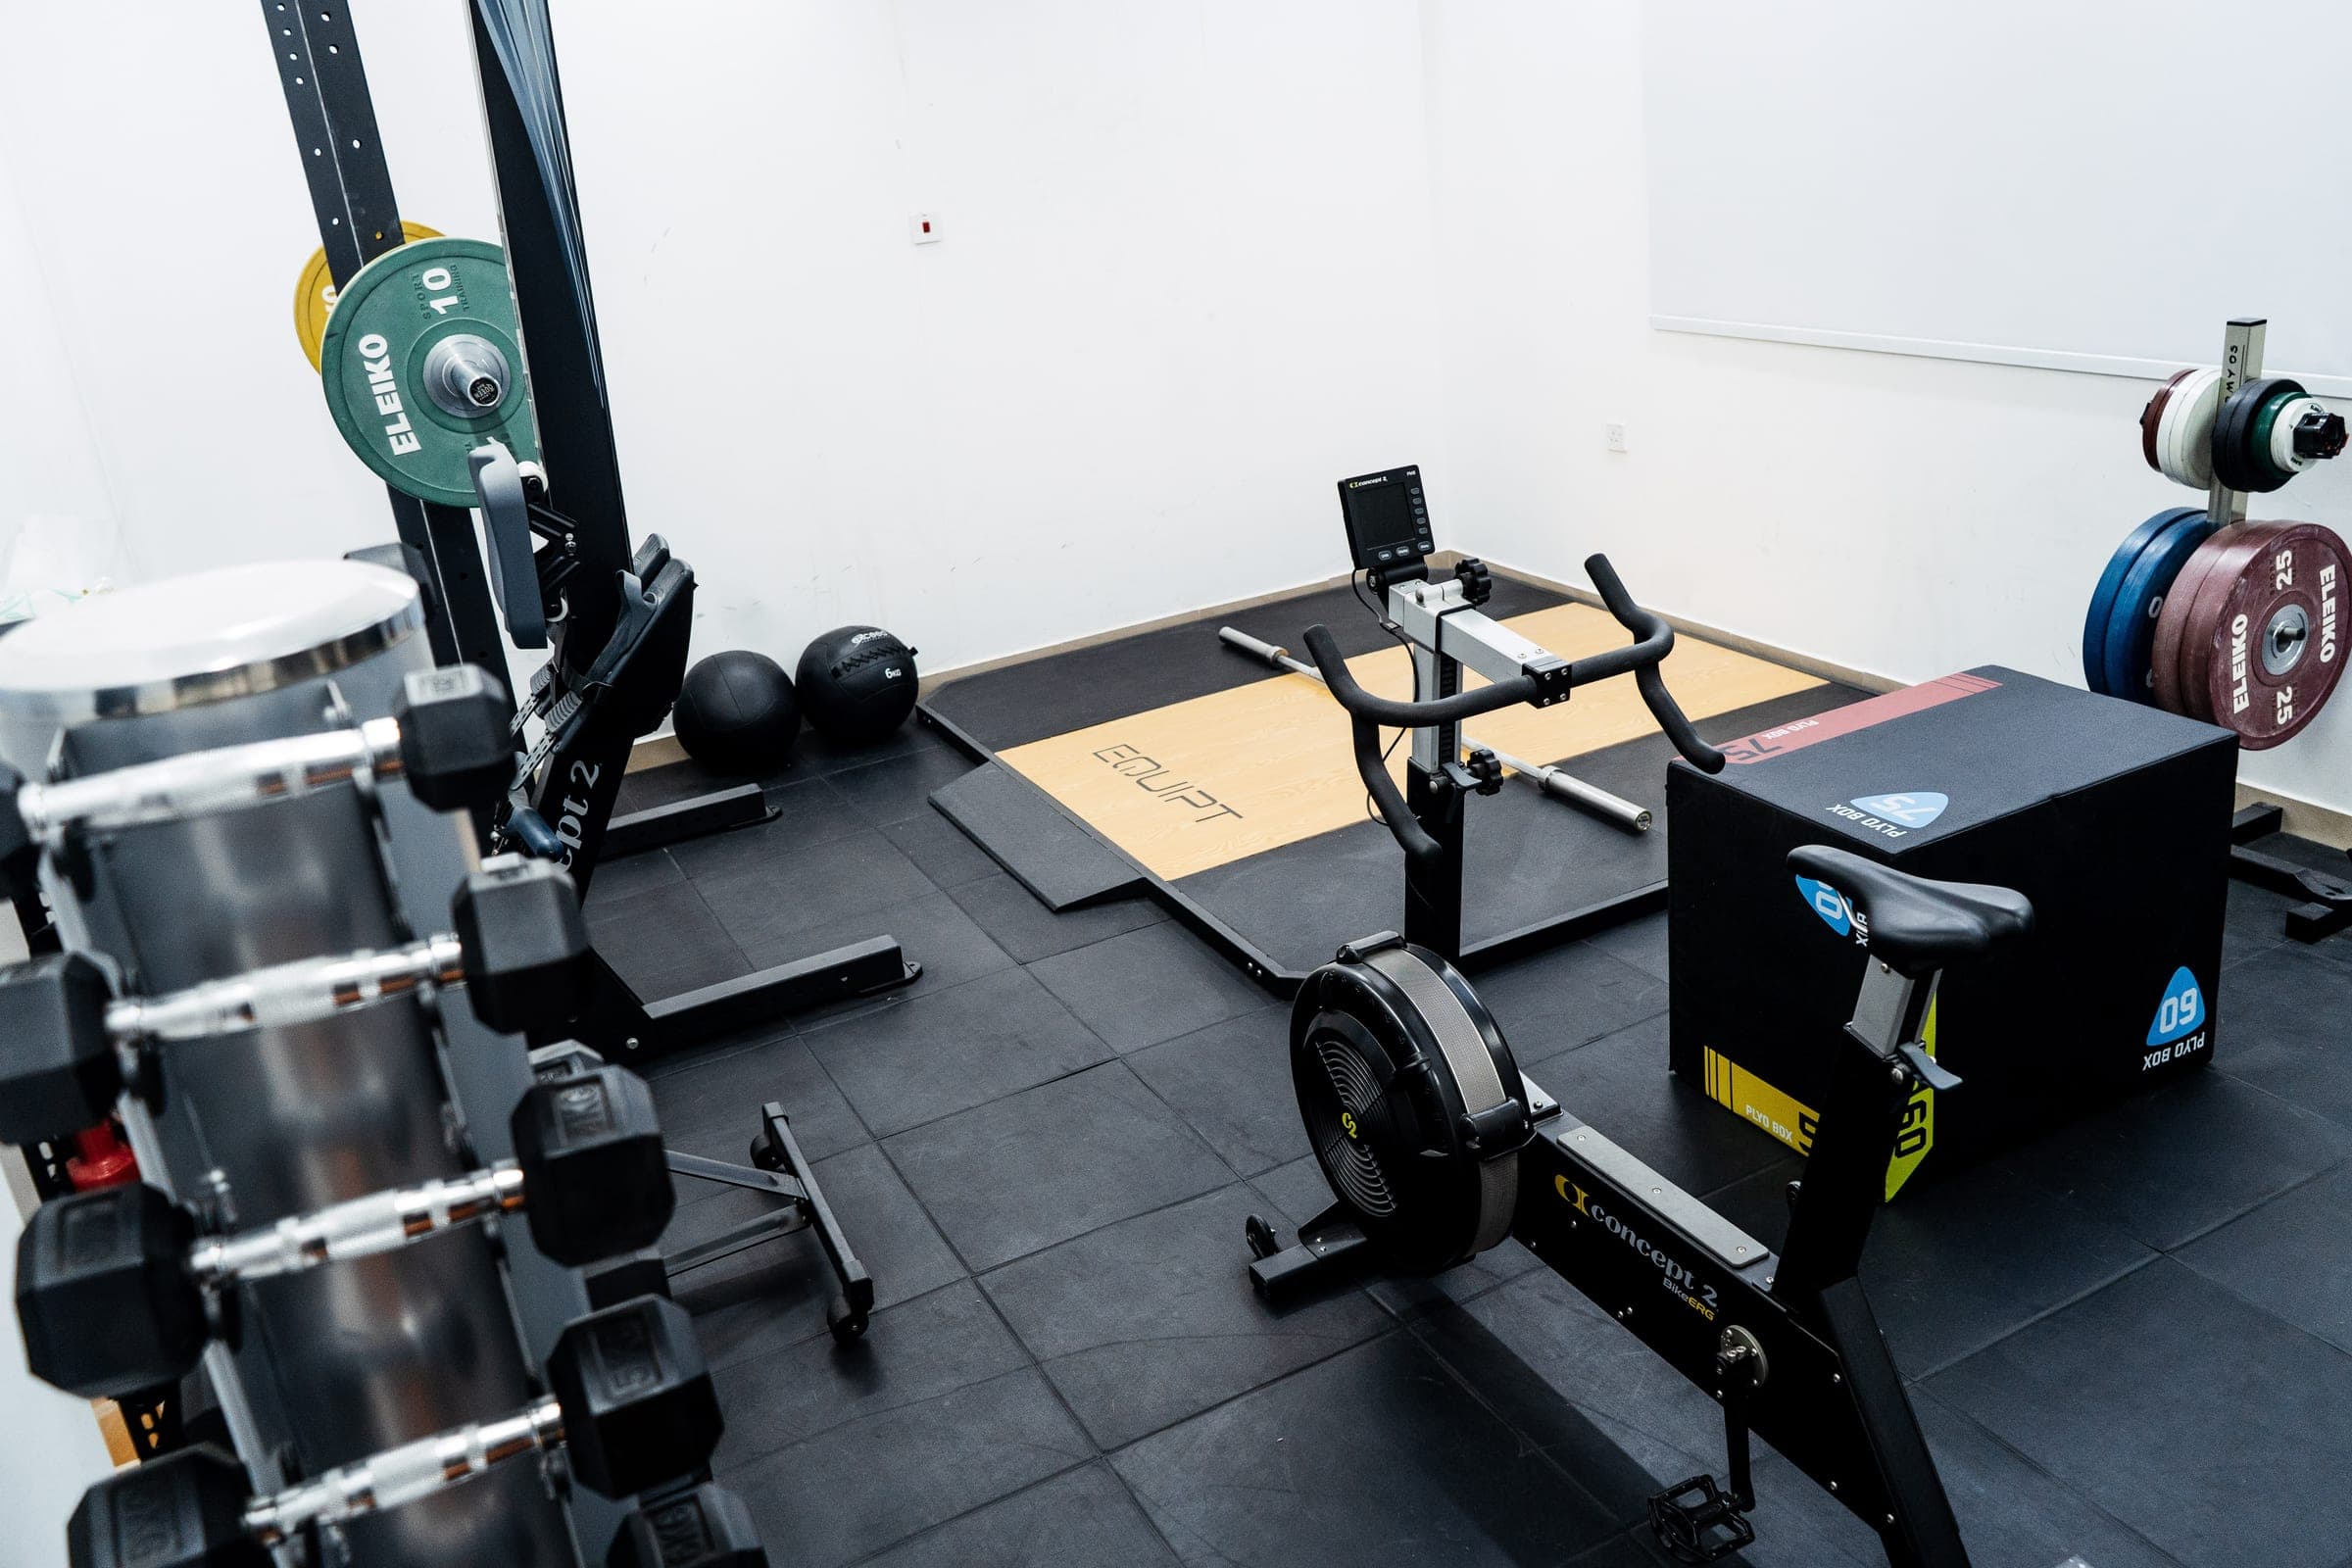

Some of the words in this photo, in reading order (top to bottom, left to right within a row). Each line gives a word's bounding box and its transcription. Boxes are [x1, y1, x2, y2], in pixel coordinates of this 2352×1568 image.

[422, 268, 459, 315] 10
[359, 333, 421, 456] ELEIKO
[2276, 550, 2292, 590] 25
[2320, 564, 2336, 662] ELEIKO
[885, 667, 902, 679] 6KG
[2231, 613, 2249, 714] ELEIKO
[2277, 686, 2292, 725] 25
[570, 760, 600, 789] 2
[1093, 744, 1244, 822] EQUIPT
[1826, 804, 1867, 820] BOX
[1860, 817, 1908, 838] PLYO
[1870, 795, 1937, 821] 75
[2159, 987, 2197, 1034] 60
[2142, 1047, 2172, 1071] BOX
[2175, 1031, 2205, 1057] PLYO
[1745, 1104, 1770, 1129] PLYO
[1772, 1121, 1792, 1144] BOX
[1591, 1204, 1694, 1290] concept
[1701, 1284, 1718, 1308] 2
[1662, 1277, 1715, 1321] BikeERG
